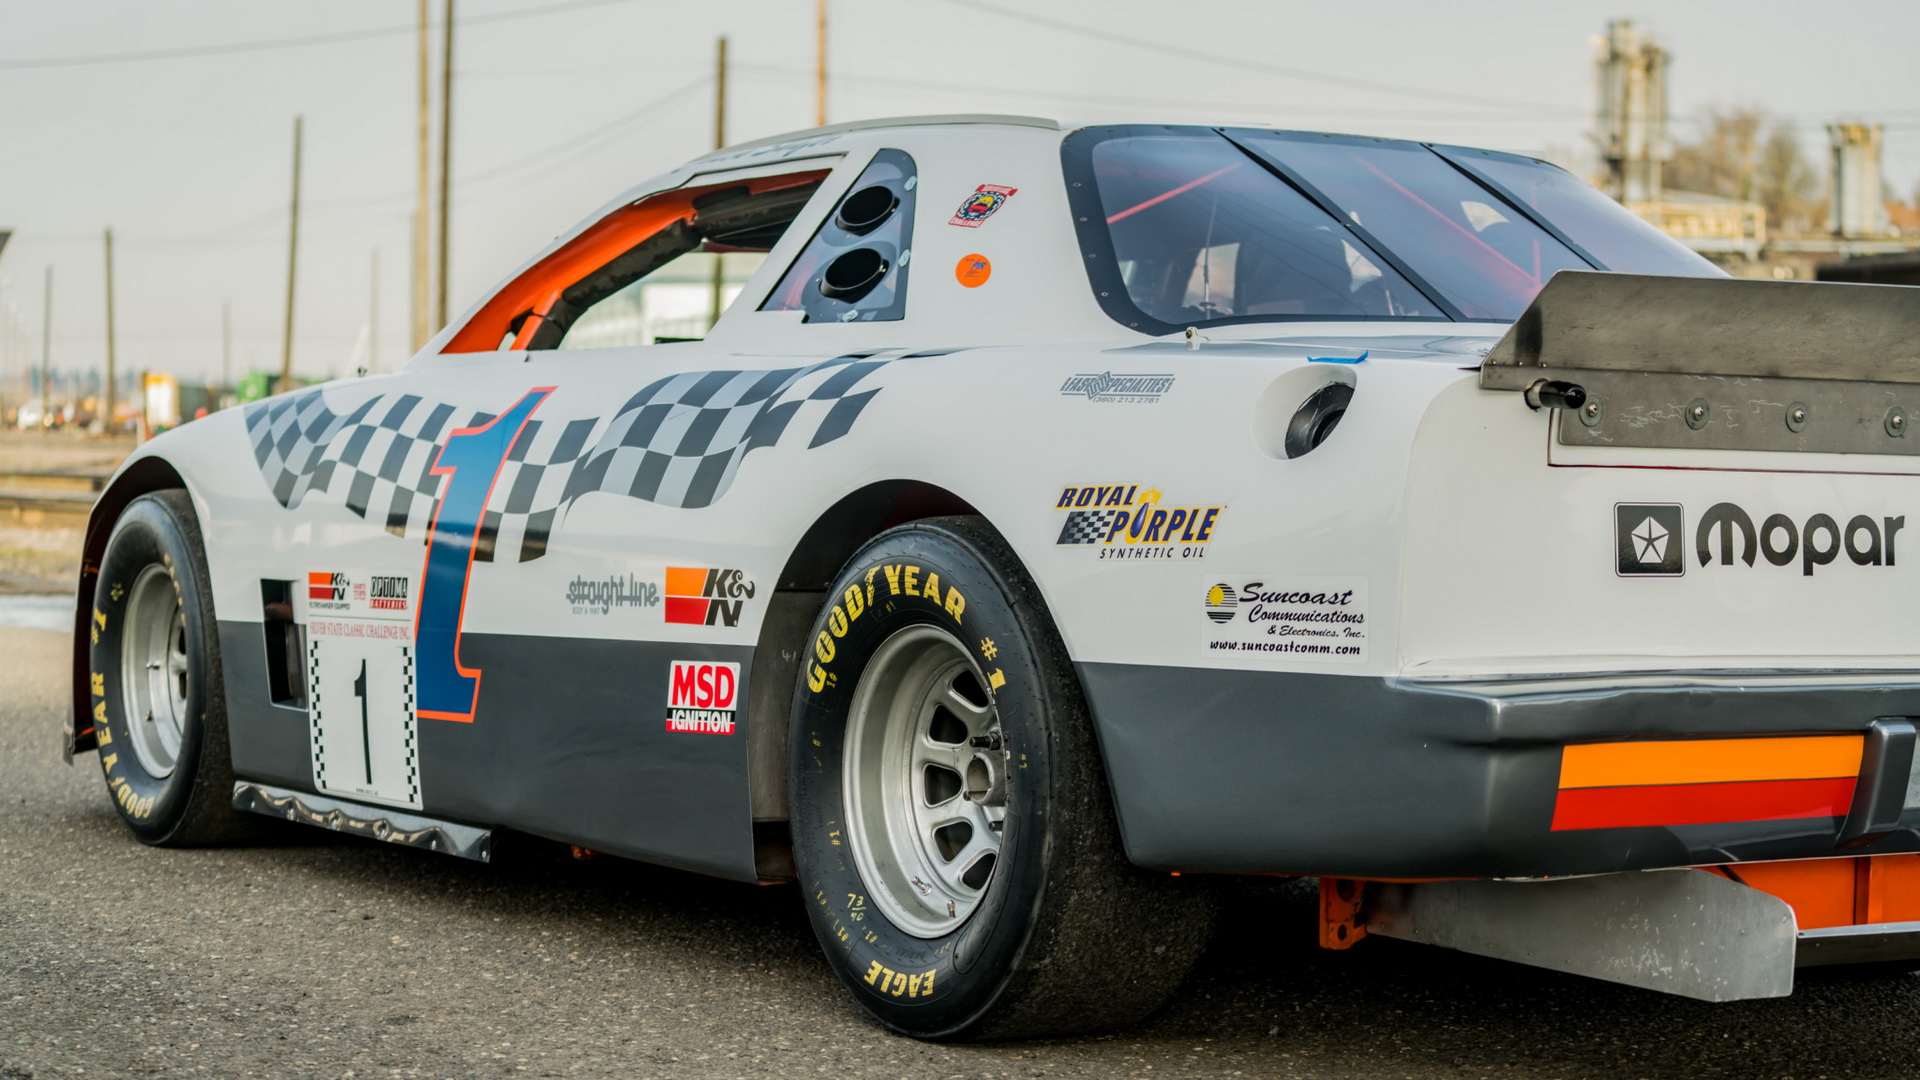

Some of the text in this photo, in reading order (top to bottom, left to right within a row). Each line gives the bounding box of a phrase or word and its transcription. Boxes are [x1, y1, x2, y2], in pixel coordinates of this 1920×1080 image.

[1101, 377, 1170, 393] SPECIALTIES
[1056, 485, 1138, 508] ROYAL
[1105, 506, 1220, 544] PURPLE
[414, 385, 559, 724] 1
[1100, 546, 1204, 559] SYNTHETIC OIL
[370, 576, 408, 598] OPTIMA
[1239, 582, 1353, 605] Suncoast
[371, 599, 406, 610] BATTERIES
[1248, 603, 1366, 624] Communications
[343, 623, 365, 637] CLASSIC
[366, 623, 398, 640] CHALLENGE
[1267, 625, 1276, 635] &
[1343, 627, 1365, 638] Inc.
[1210, 640, 1361, 655] www.suncoastcomm.com
[671, 664, 735, 708] MSD
[353, 659, 372, 785] 1
[671, 709, 732, 733] IGNITION
[863, 959, 937, 998] EAGLE
